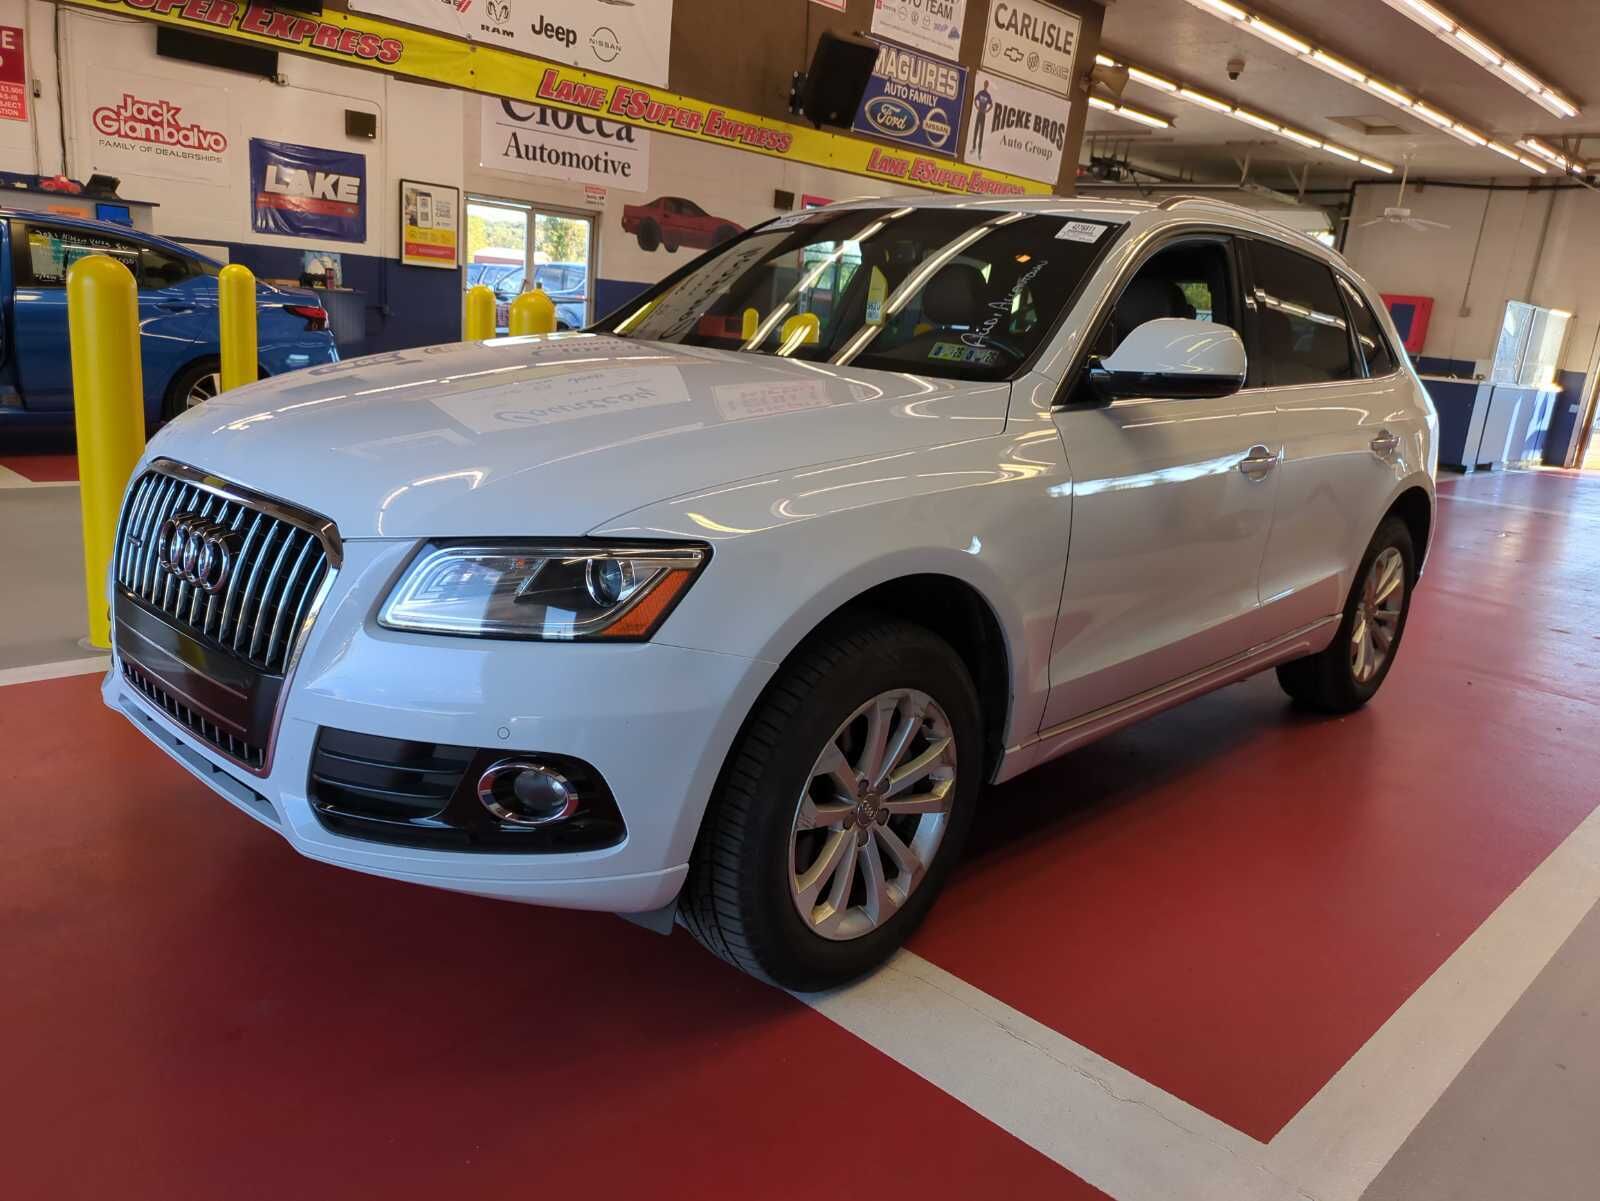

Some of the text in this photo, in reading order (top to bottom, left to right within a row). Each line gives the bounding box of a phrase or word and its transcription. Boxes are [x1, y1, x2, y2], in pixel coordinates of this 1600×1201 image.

[239, 0, 403, 63] EXPRESS
[481, 24, 514, 38] RAM
[531, 14, 577, 48] Jeep
[588, 37, 623, 53] NISSAN
[994, 3, 1074, 56] CARLISLE
[873, 45, 959, 99] MAGUIRES
[117, 93, 181, 126] Jack
[536, 68, 608, 110] LANE
[703, 108, 793, 152] EXPRESS
[884, 81, 939, 107] AUTO FAMILY
[93, 107, 227, 153] Giambalvo
[877, 103, 908, 129] Ford
[924, 120, 949, 134] NISSAN
[991, 102, 1065, 151] RICKE BROS
[99, 140, 223, 163] FAMILY OF DEALERSHIPS
[502, 131, 632, 178] Automotive
[866, 147, 909, 178] LANE
[1000, 134, 1053, 160] Auto Group
[264, 164, 361, 204] LAKE
